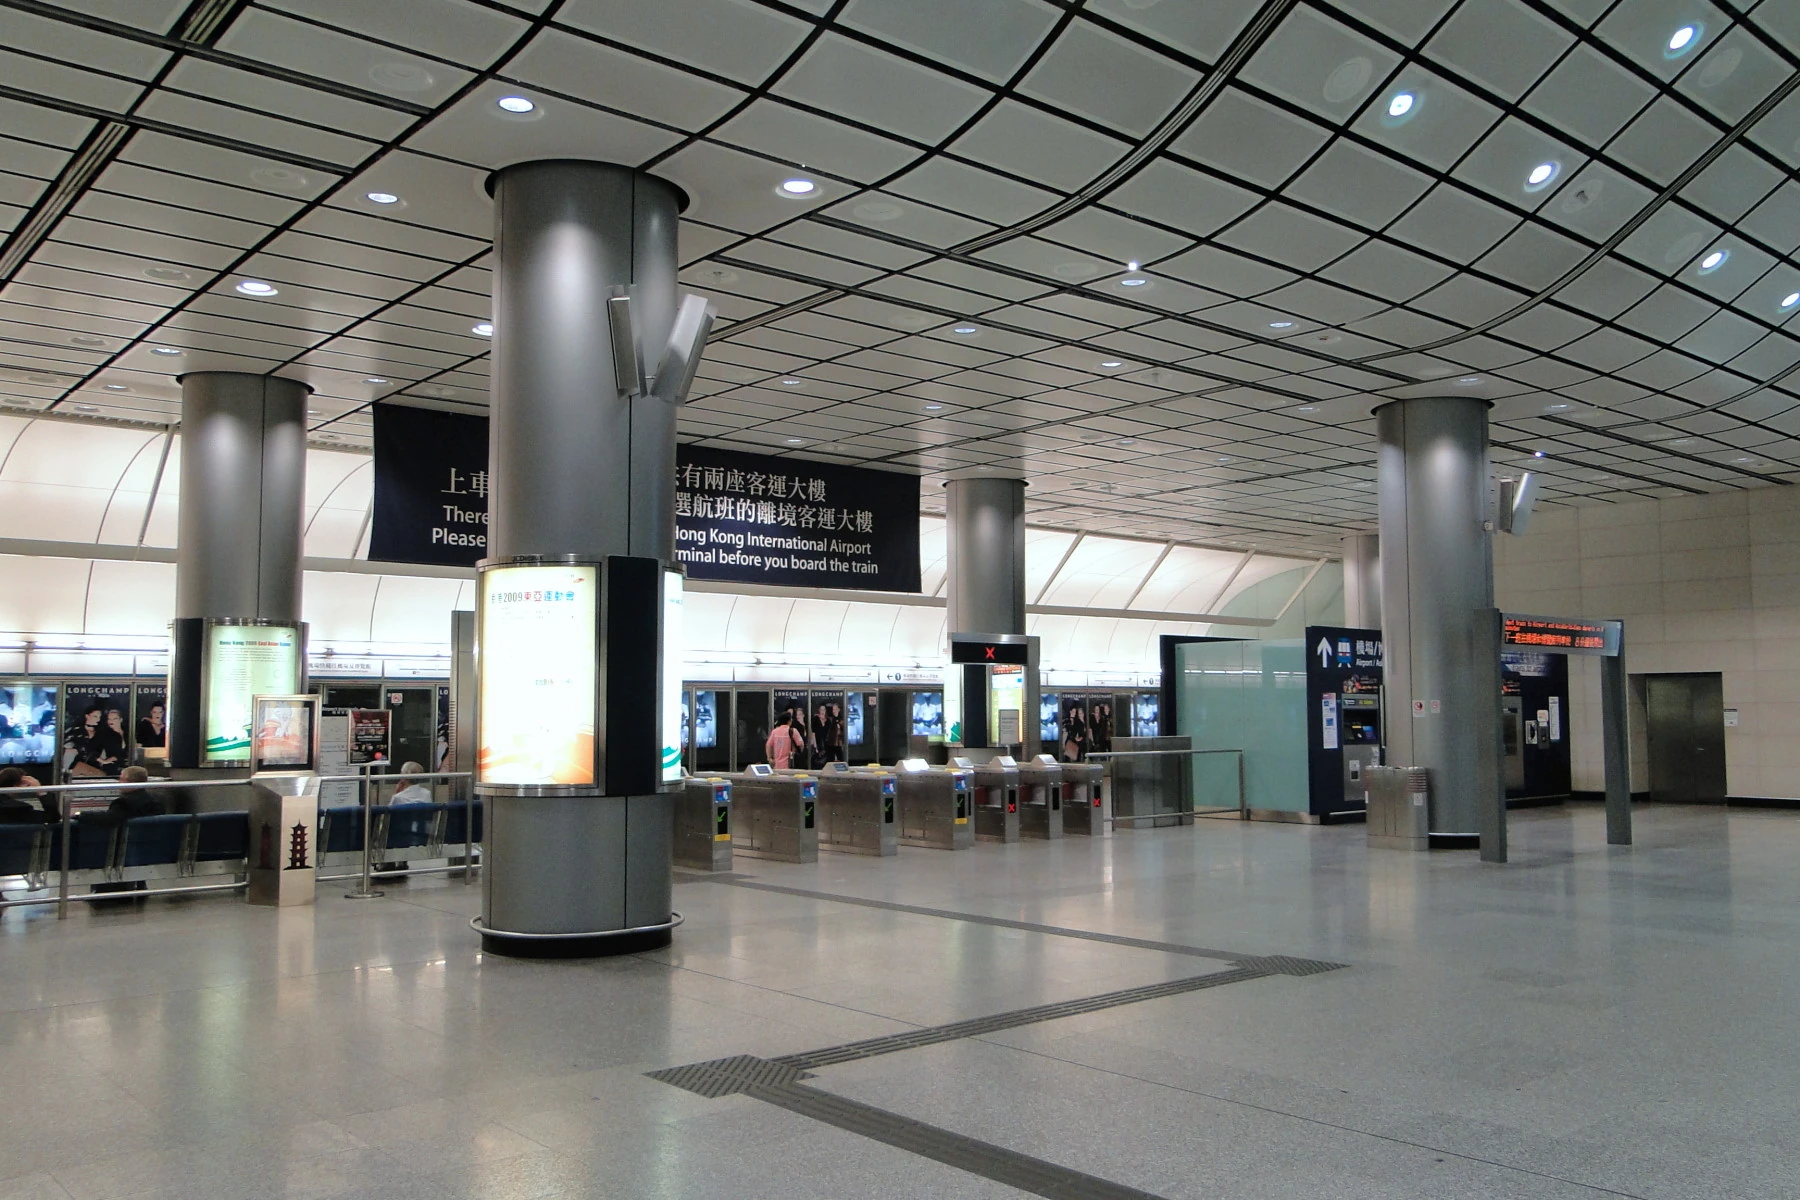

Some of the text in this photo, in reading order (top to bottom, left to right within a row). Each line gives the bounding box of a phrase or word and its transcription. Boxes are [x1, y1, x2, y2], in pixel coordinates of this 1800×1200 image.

[432, 527, 878, 574] Please minal before you board the train
[442, 505, 871, 556] There ong Kong International Airport
[1356, 658, 1372, 668] Airport
